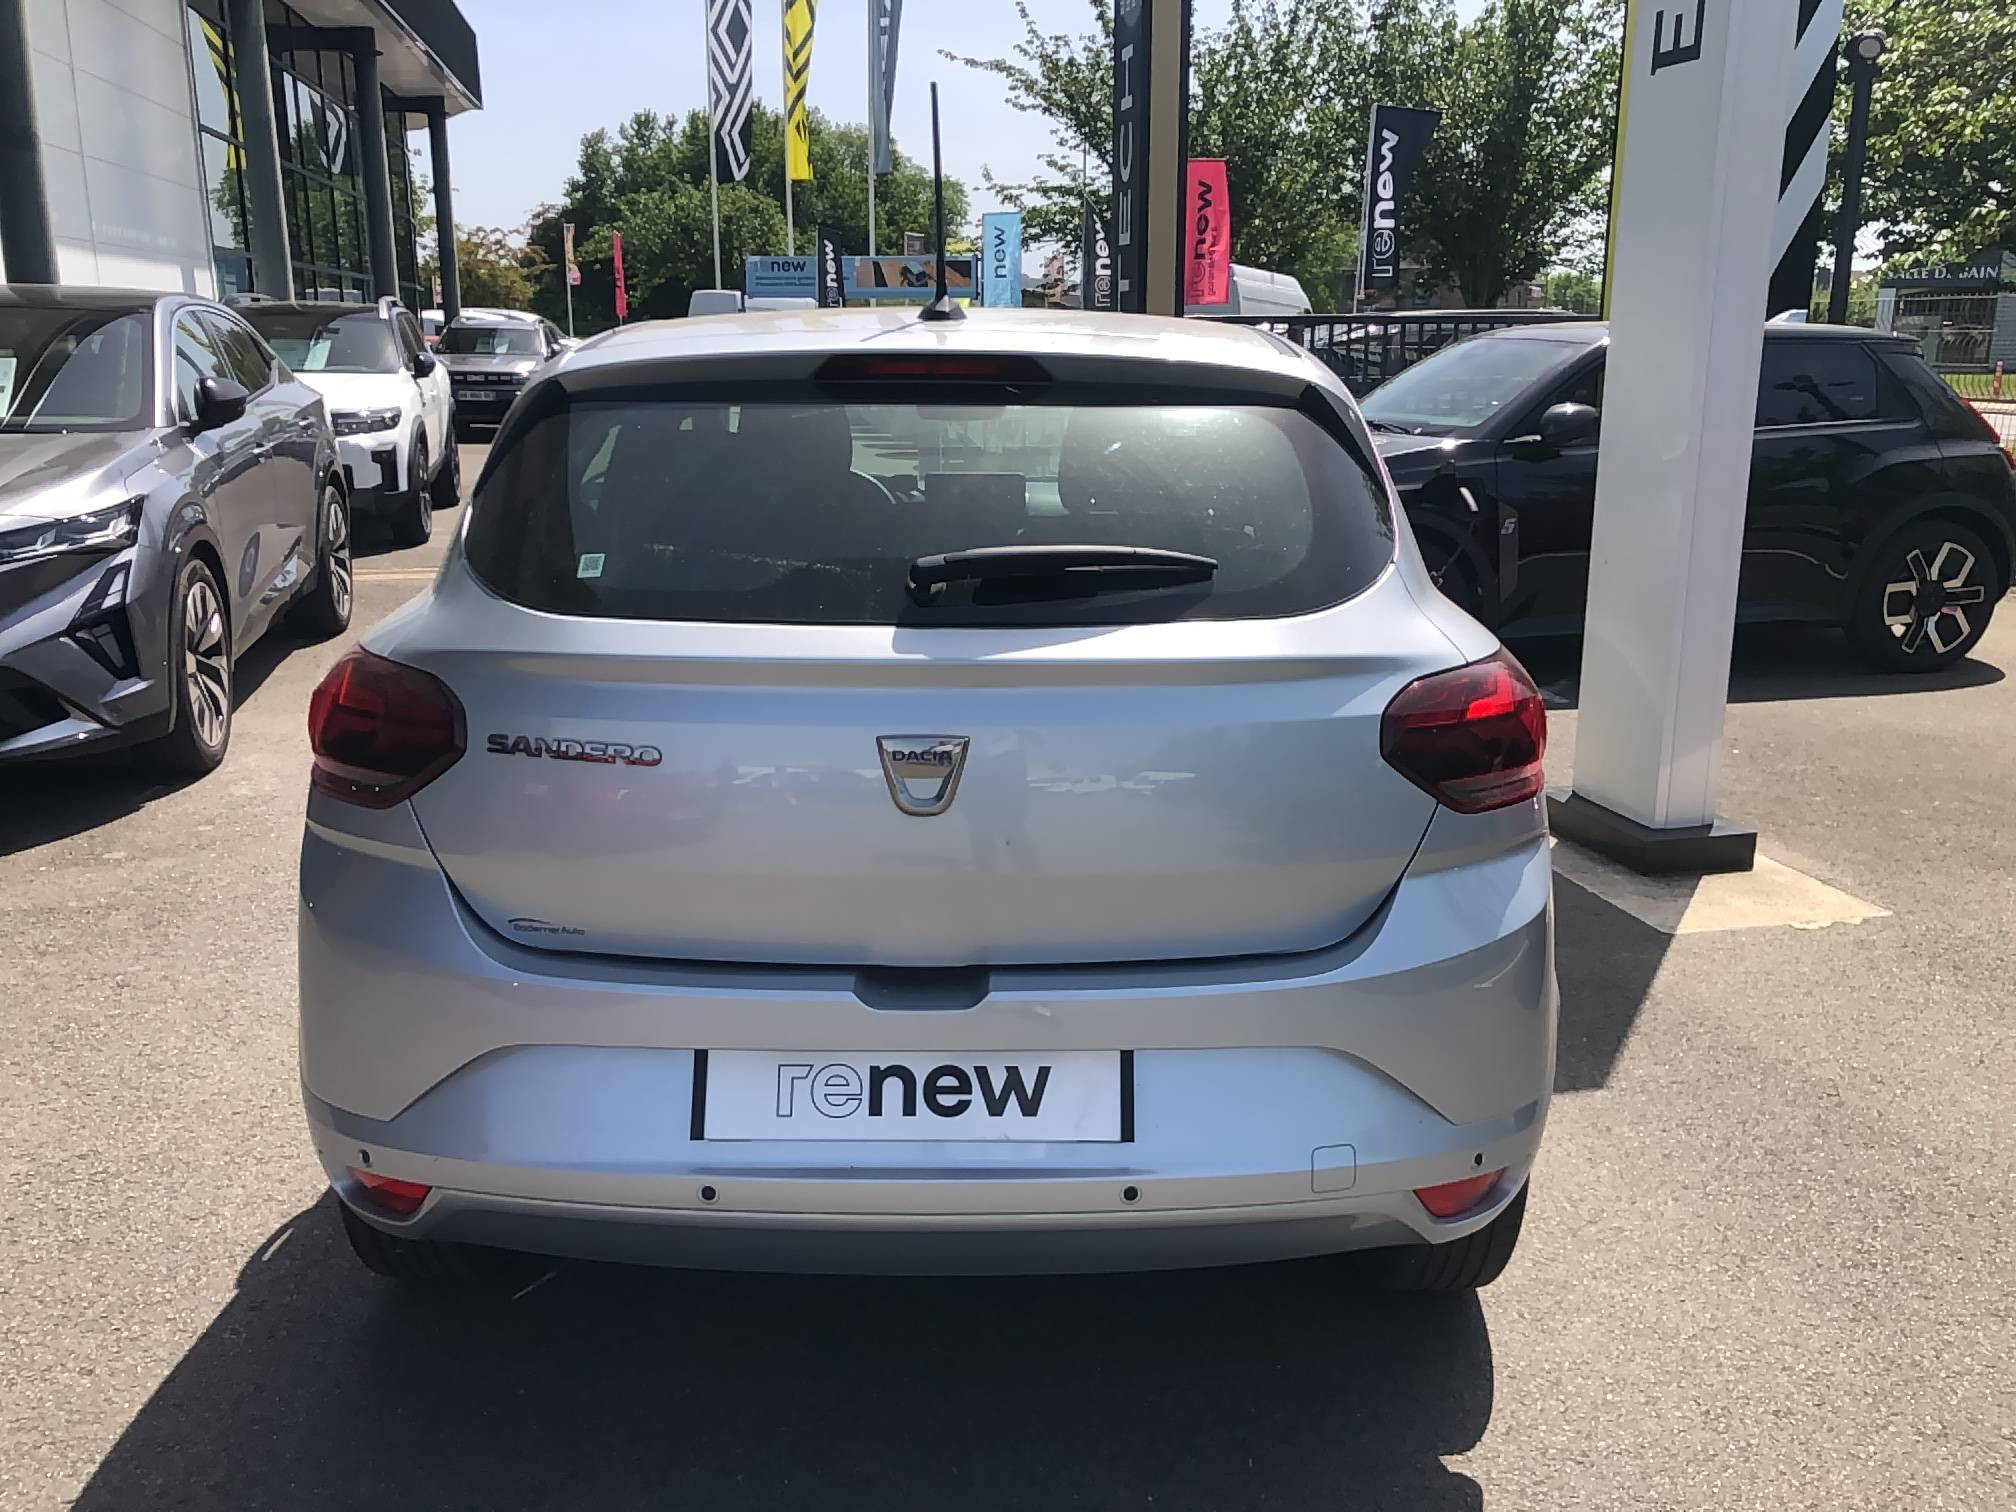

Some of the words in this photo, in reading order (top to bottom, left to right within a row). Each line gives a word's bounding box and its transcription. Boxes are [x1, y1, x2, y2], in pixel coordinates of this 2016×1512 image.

[1117, 43, 1135, 311] TECH
[1371, 128, 1400, 277] renew
[1093, 213, 1112, 307] renew
[1189, 180, 1213, 298] renew
[487, 733, 662, 767] SANDERO
[891, 750, 952, 765] DACIA
[776, 1063, 1052, 1118] renew
